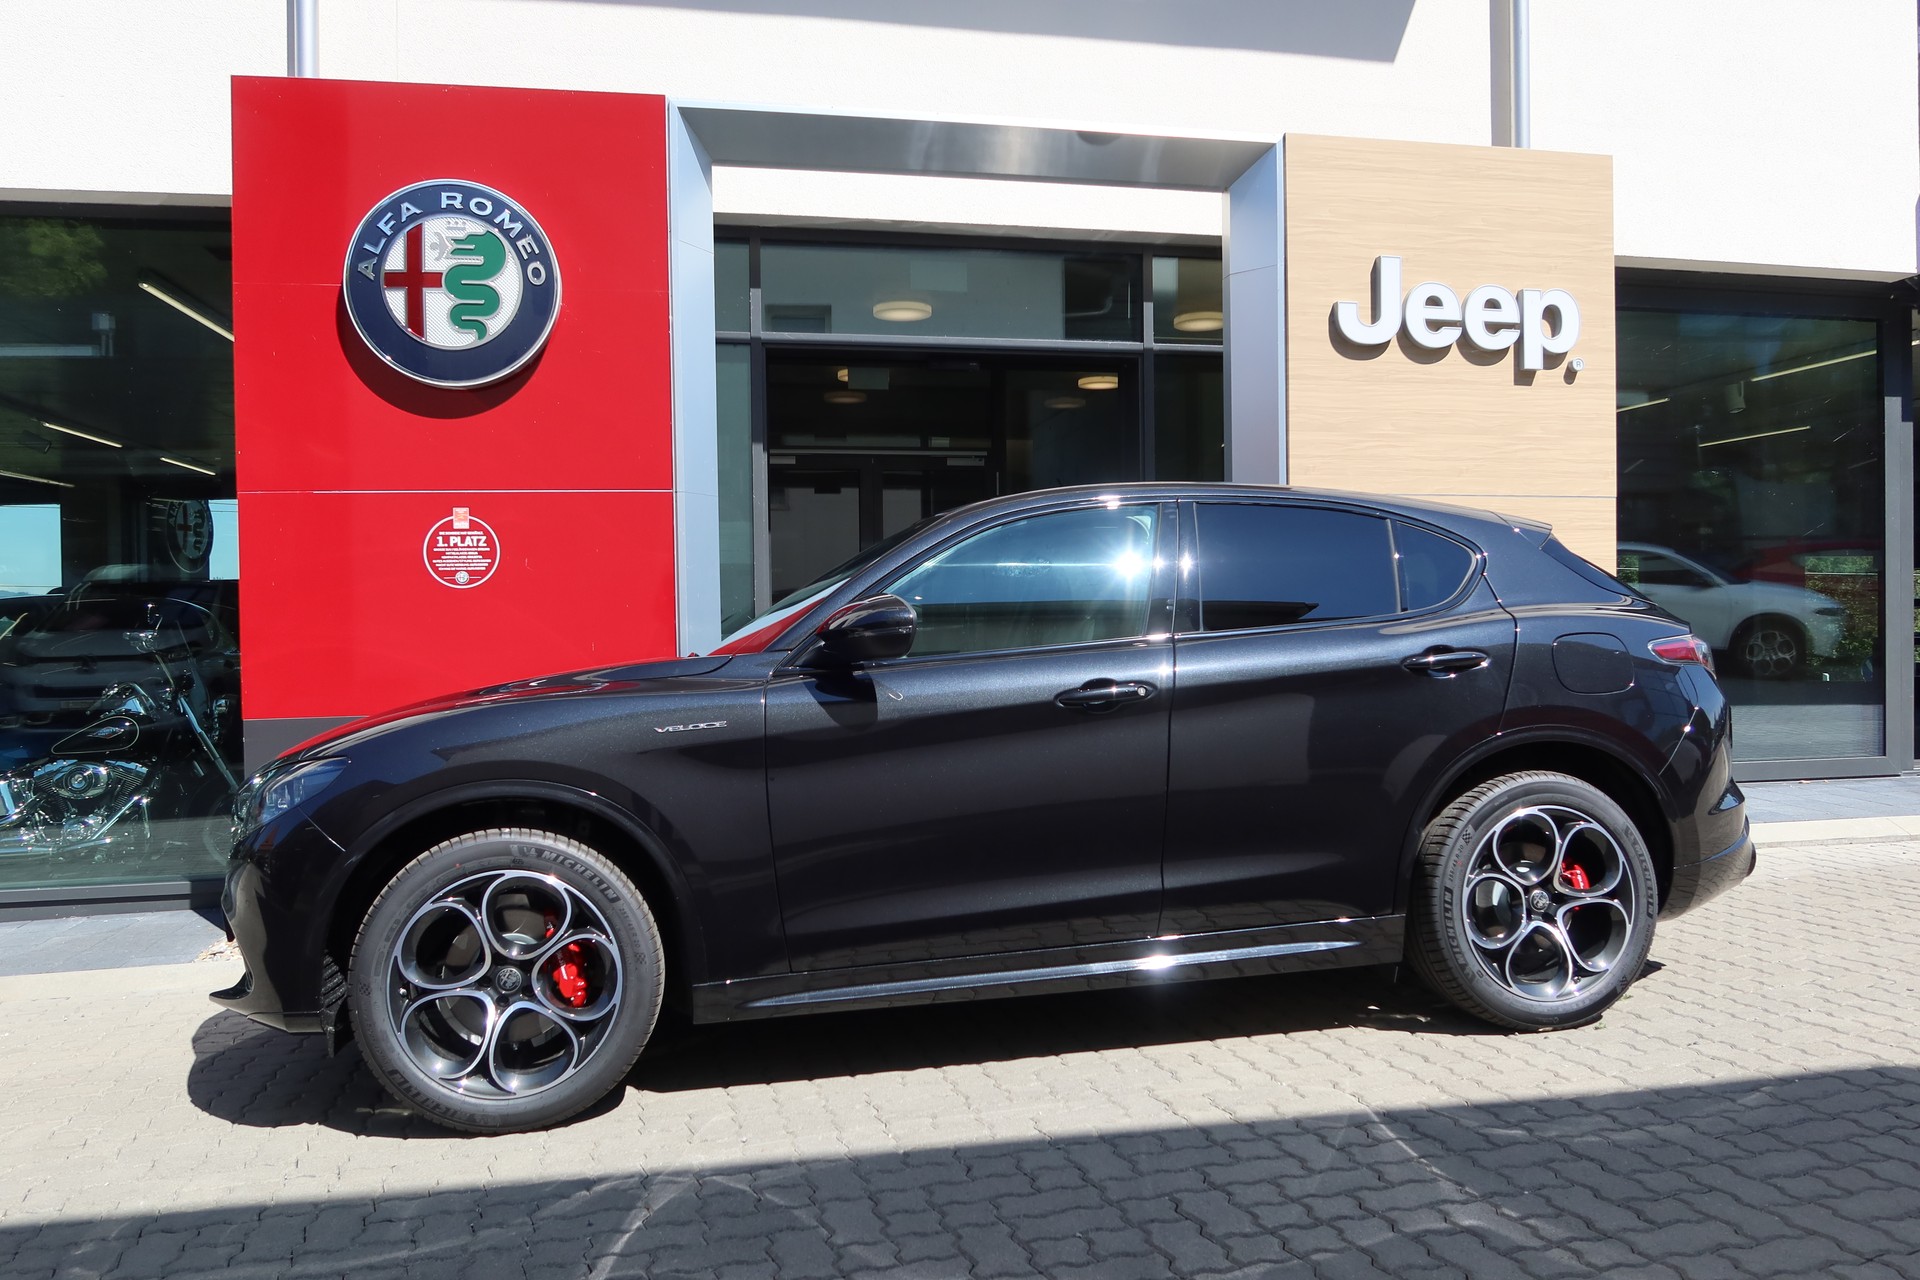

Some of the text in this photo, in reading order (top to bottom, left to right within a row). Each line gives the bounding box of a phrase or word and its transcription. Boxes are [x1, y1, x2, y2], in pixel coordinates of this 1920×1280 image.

[358, 191, 547, 286] ALFA ROMEO
[1333, 255, 1581, 371] Jeep
[436, 535, 487, 546] 1. PLATZ
[653, 720, 728, 733] VELOCE
[541, 849, 618, 900] MICHELIN
[1443, 890, 1466, 965] MICHELIN
